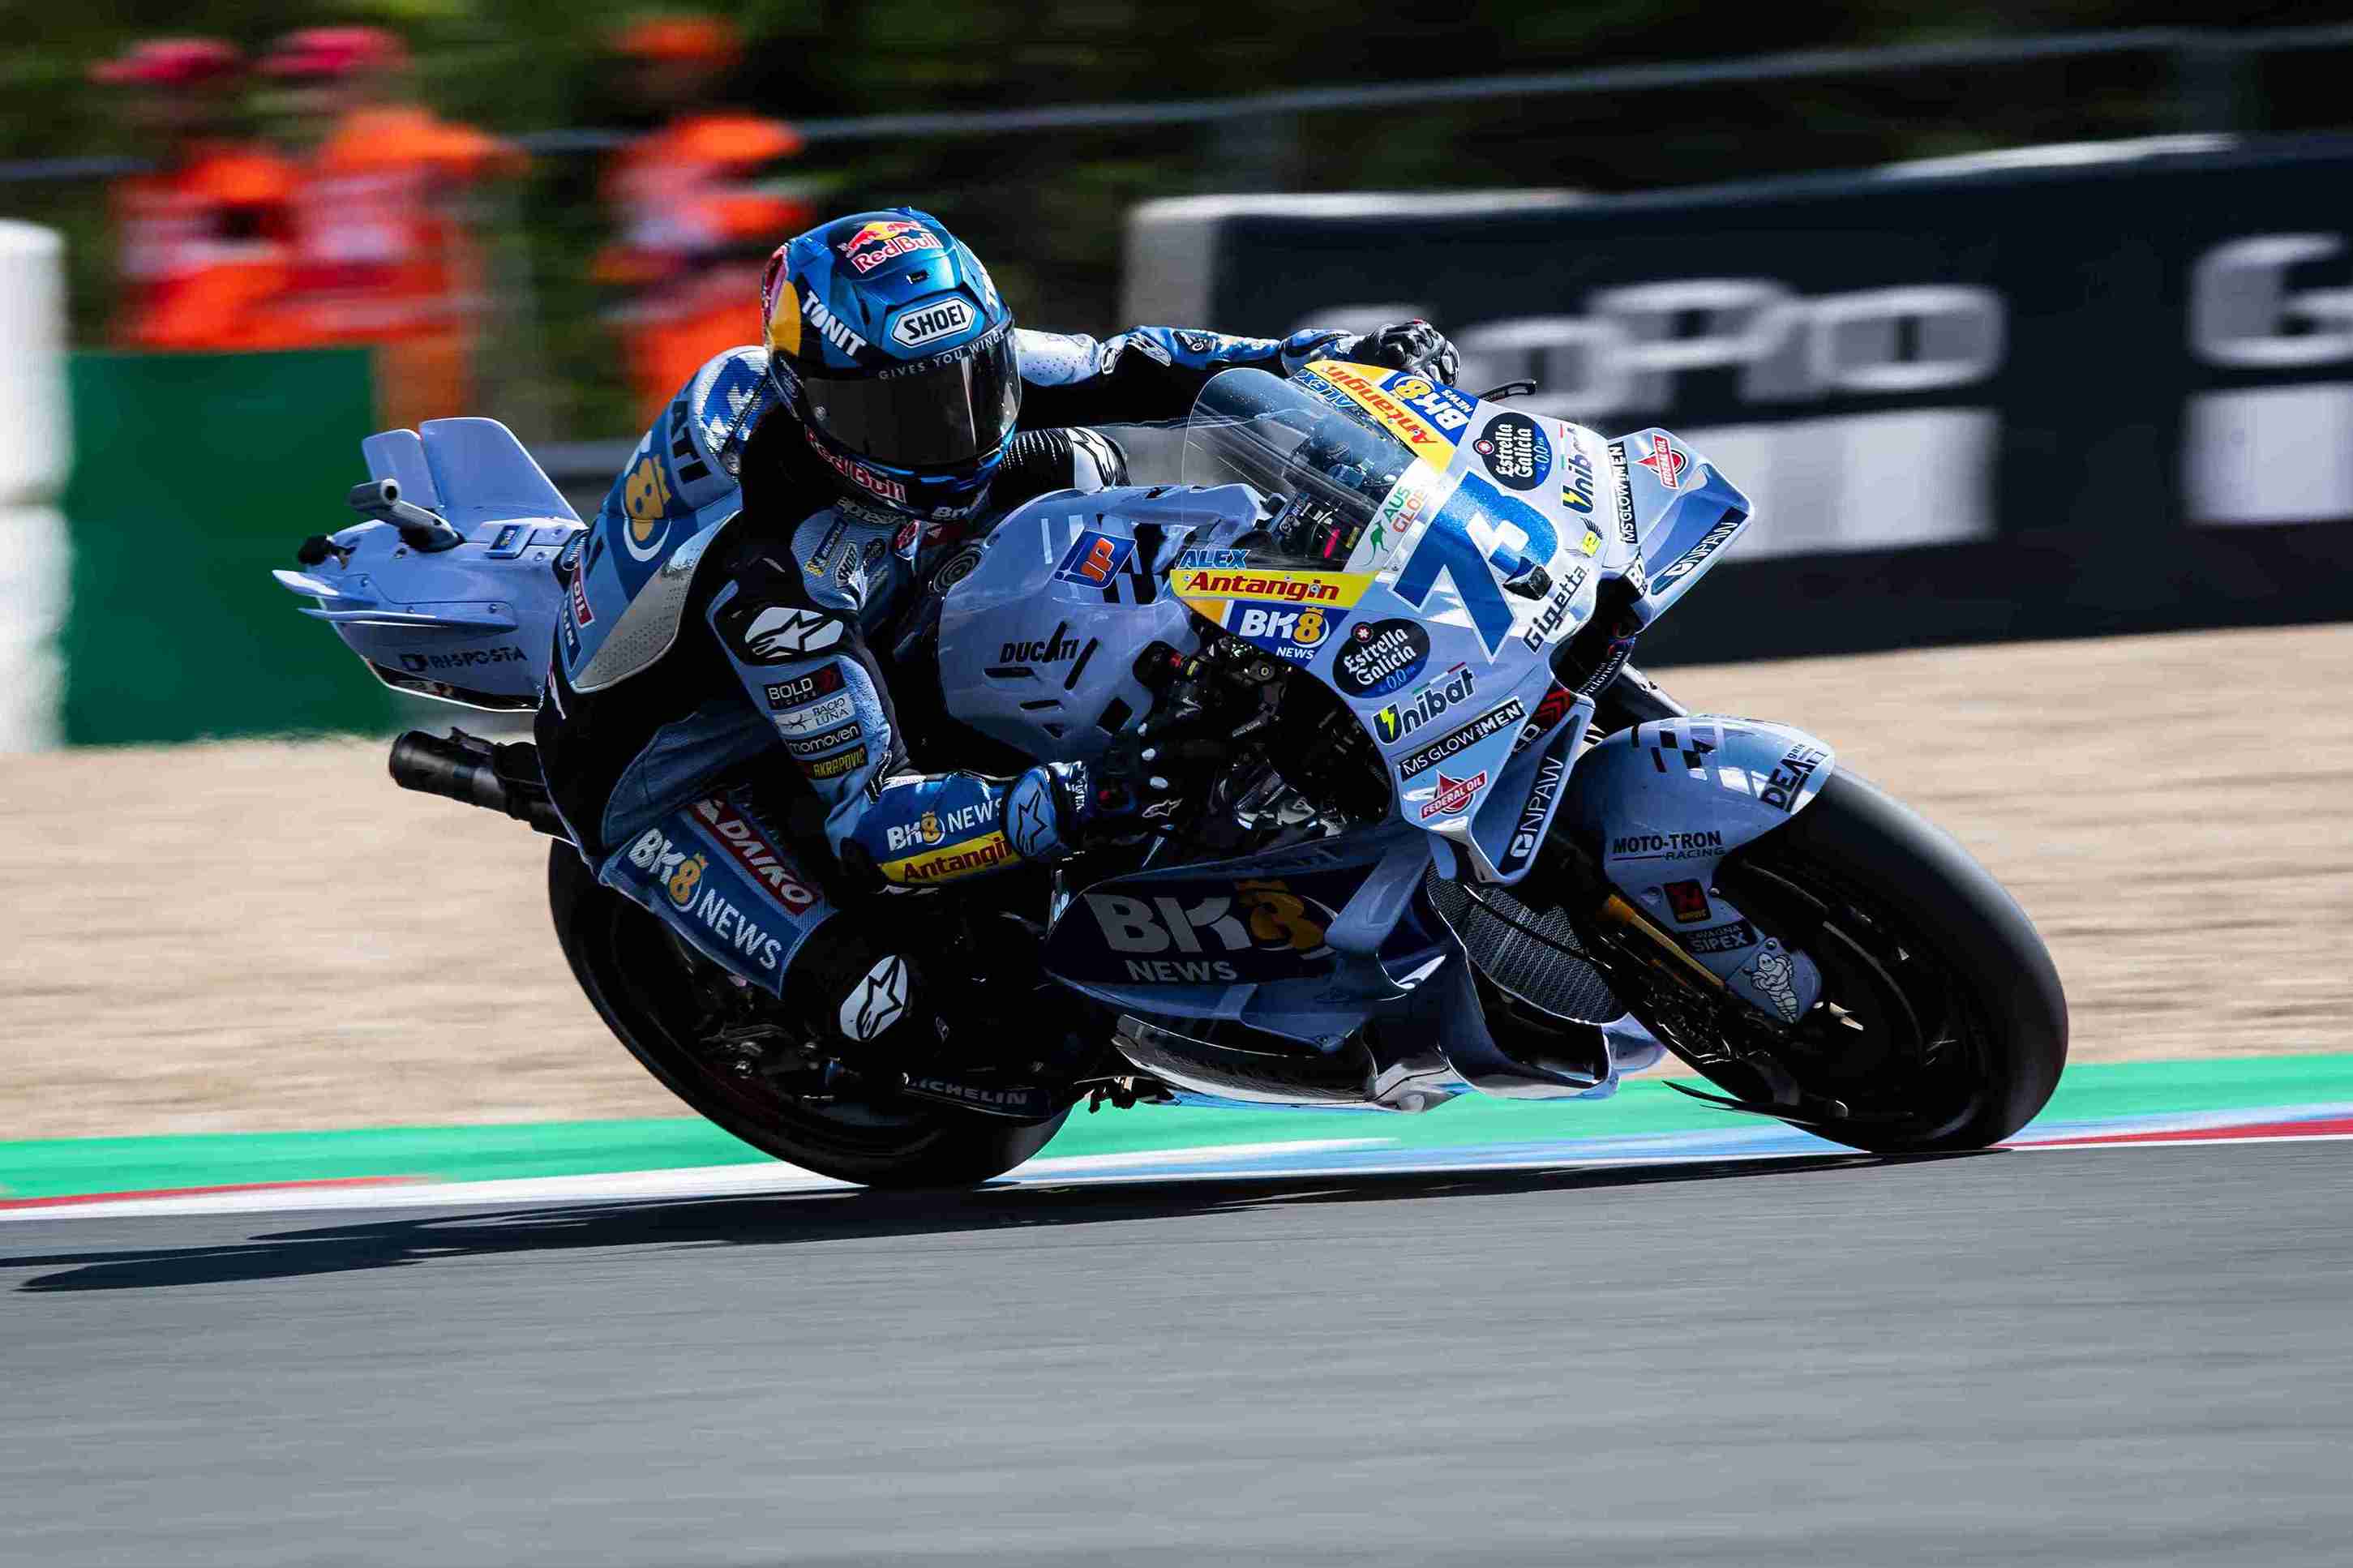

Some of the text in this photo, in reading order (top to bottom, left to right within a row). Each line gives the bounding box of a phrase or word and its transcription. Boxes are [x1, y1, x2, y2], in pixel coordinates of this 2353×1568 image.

[851, 233, 943, 273] Red Bull
[902, 304, 966, 341] SHOEI
[878, 331, 1005, 380] GIVES YOU WINGS
[1297, 370, 1357, 409] ALEX
[1391, 375, 1470, 431] BK8
[1440, 389, 1475, 413] NEWS
[1494, 423, 1515, 478] Estrella
[1513, 427, 1534, 478] Galicia
[849, 459, 907, 504] Bull
[1176, 549, 1251, 569] ALEX
[1185, 570, 1340, 602] Antangin
[1237, 606, 1331, 649] BK8
[1524, 564, 1588, 653] Gigetta
[999, 621, 1079, 663] DUCATI
[1275, 646, 1316, 661] NEWS
[1343, 627, 1410, 675] Estrella
[1355, 645, 1418, 687] Galicia
[767, 677, 814, 700] BOLD
[1371, 666, 1476, 746] Unibat
[1399, 751, 1429, 778] MS
[1428, 728, 1475, 765] GLOW
[1421, 776, 1486, 817] FEDERAL OIL
[1519, 756, 1565, 834] NPAW
[886, 810, 946, 851] BK8
[1612, 830, 1722, 854] MOTO-TRON
[1665, 846, 1725, 861] RACING
[628, 827, 782, 970] BK8 NEWS
[1124, 958, 1238, 983] NEWS
